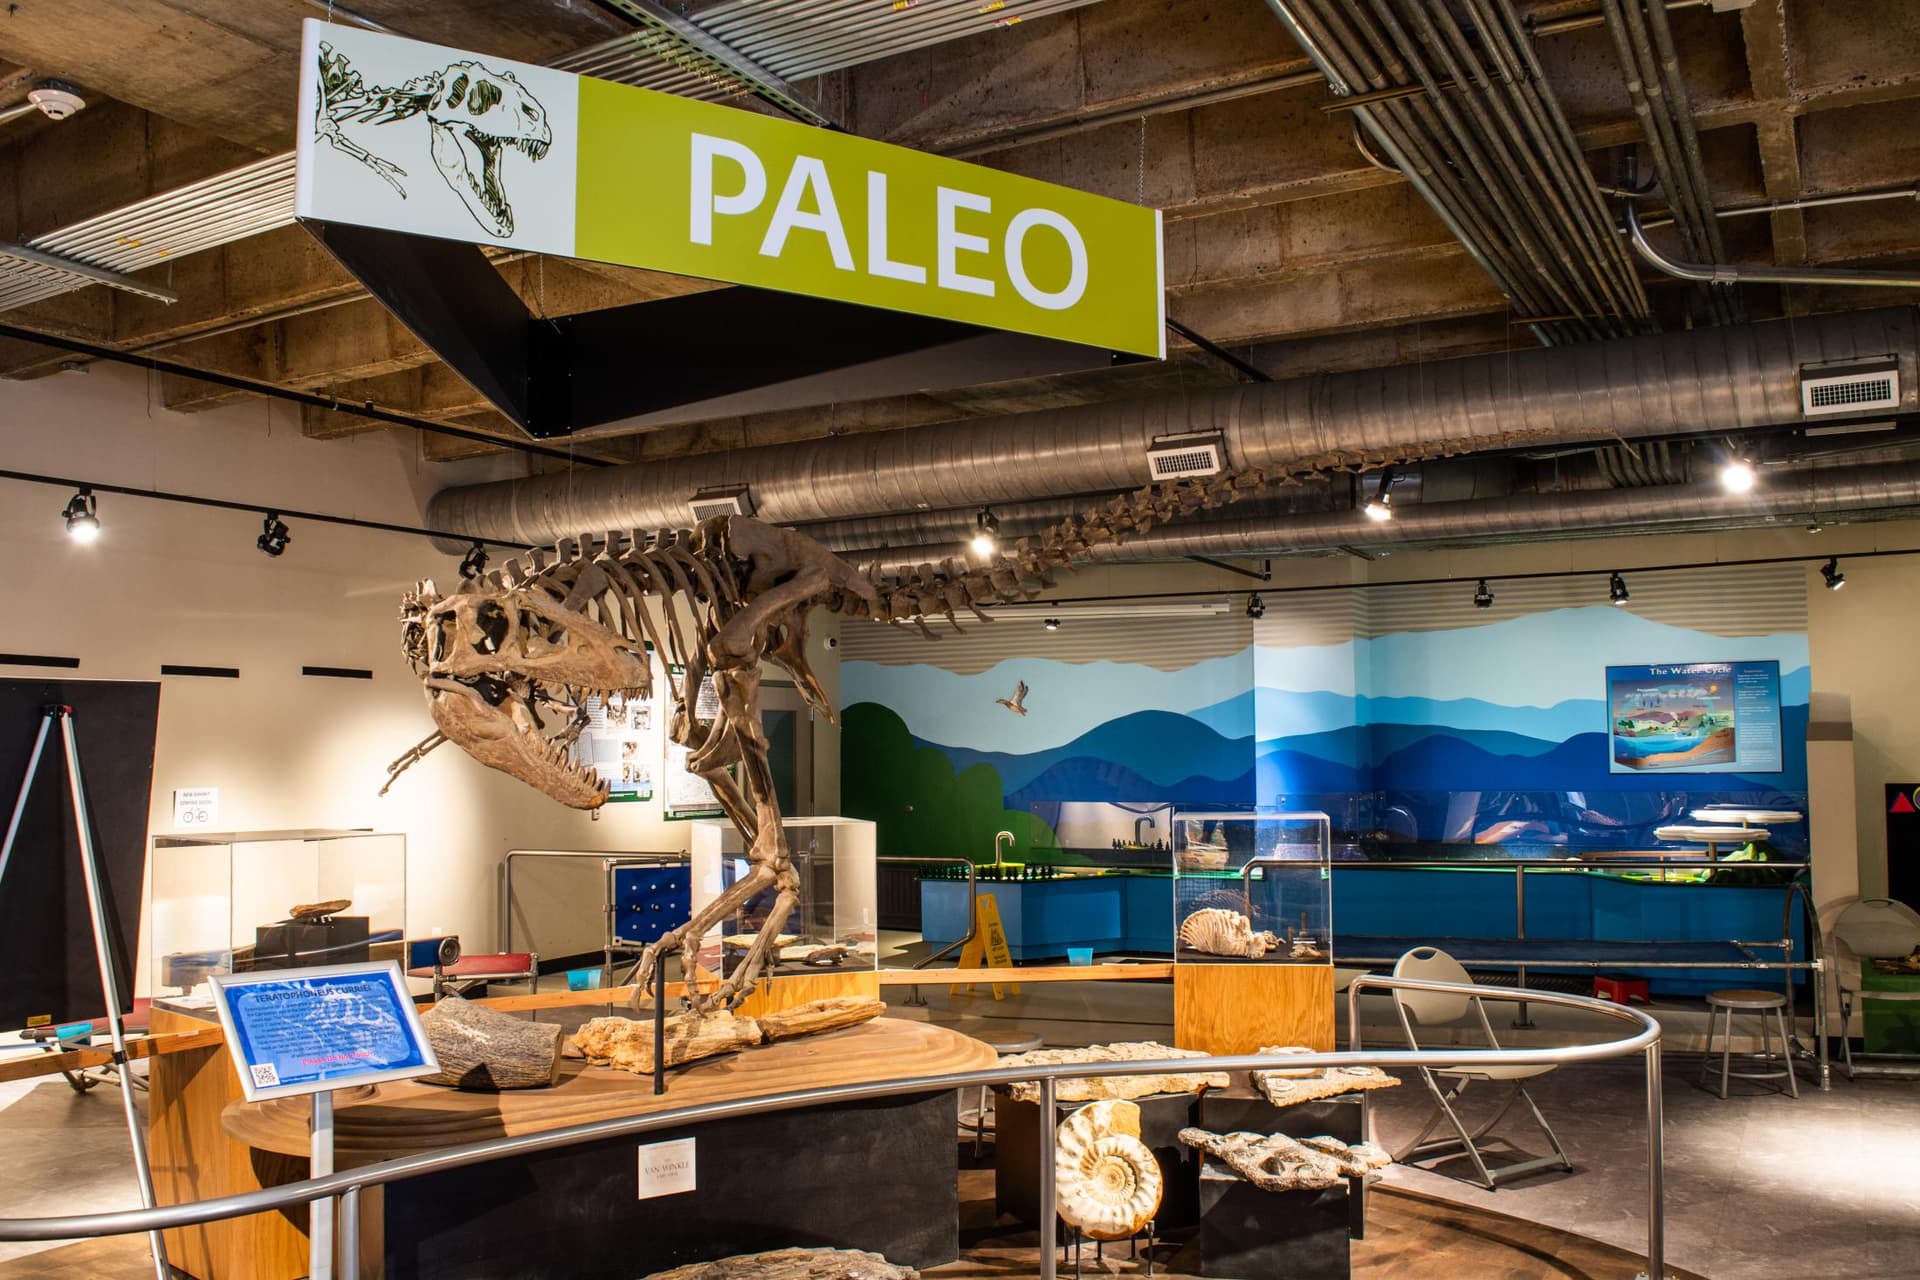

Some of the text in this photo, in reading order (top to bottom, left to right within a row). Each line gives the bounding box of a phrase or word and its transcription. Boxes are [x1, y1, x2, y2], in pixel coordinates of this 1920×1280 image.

[690, 132, 1089, 311] PALEO
[1649, 666, 1733, 676] The Water Cycle
[254, 989, 333, 1003] TERATOPHONEUS
[644, 1167, 660, 1175] VAN
